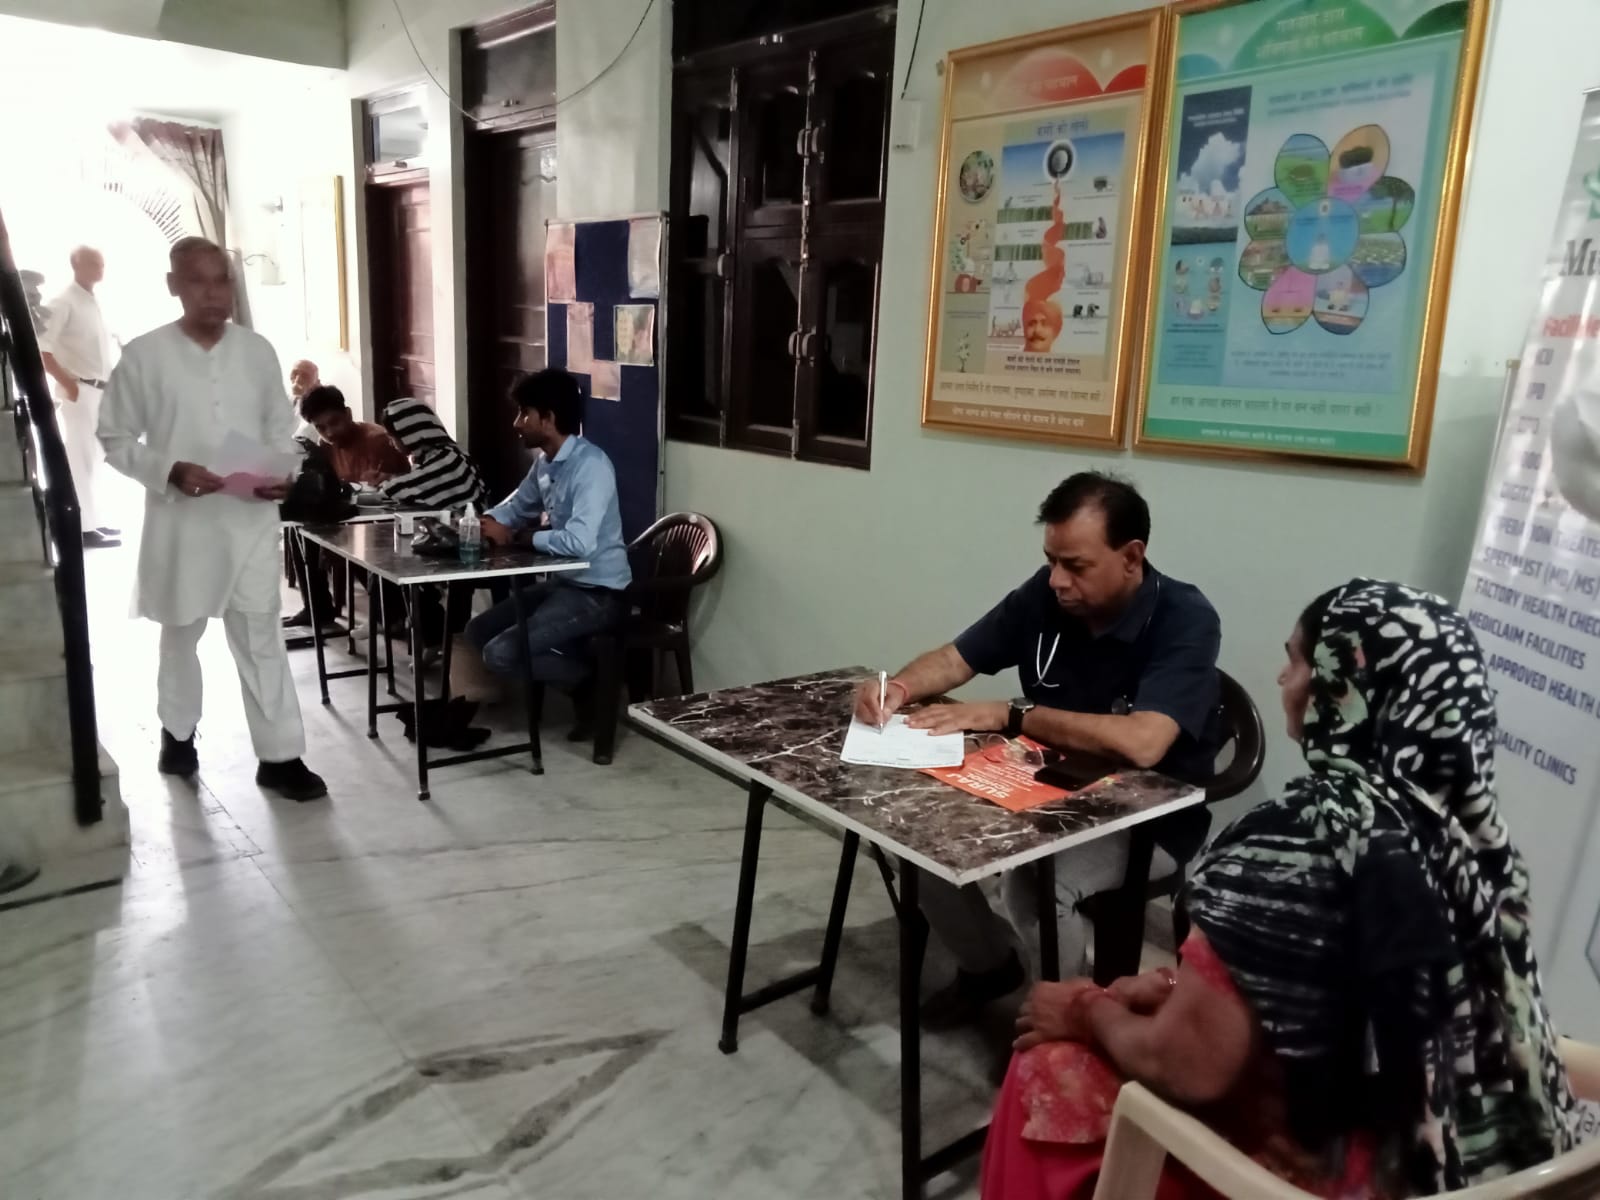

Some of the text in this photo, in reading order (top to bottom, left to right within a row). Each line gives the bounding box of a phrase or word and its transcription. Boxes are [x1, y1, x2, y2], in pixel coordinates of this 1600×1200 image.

[1475, 577, 1523, 608] FACTORY
[1522, 594, 1568, 625] HEALTH
[1467, 609, 1588, 670] MEDICLAIM FACILITIES
[1488, 653, 1548, 692] APPROVED
[1547, 679, 1596, 716] HEALTH
[945, 772, 1010, 799] SURAJ
[1534, 749, 1578, 787] CLINICS
